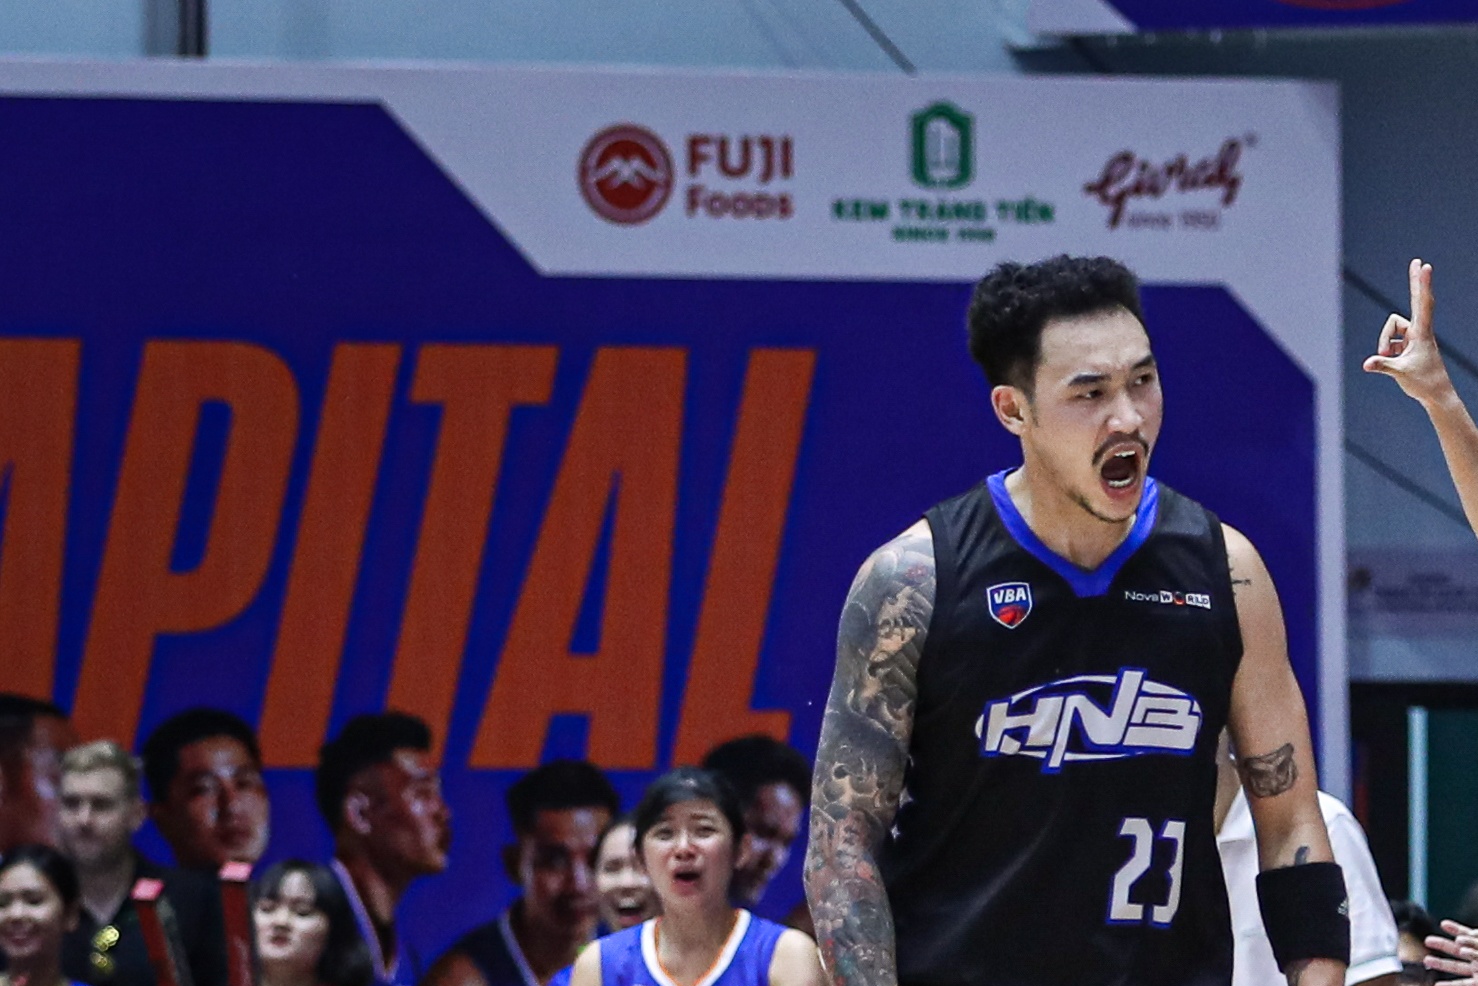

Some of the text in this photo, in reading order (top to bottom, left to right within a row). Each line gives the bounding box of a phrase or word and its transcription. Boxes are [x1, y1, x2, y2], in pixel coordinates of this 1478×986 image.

[685, 133, 794, 184] FUJI
[993, 587, 1027, 604] VBA
[982, 668, 1202, 769] HNB
[1106, 816, 1187, 927] 23
